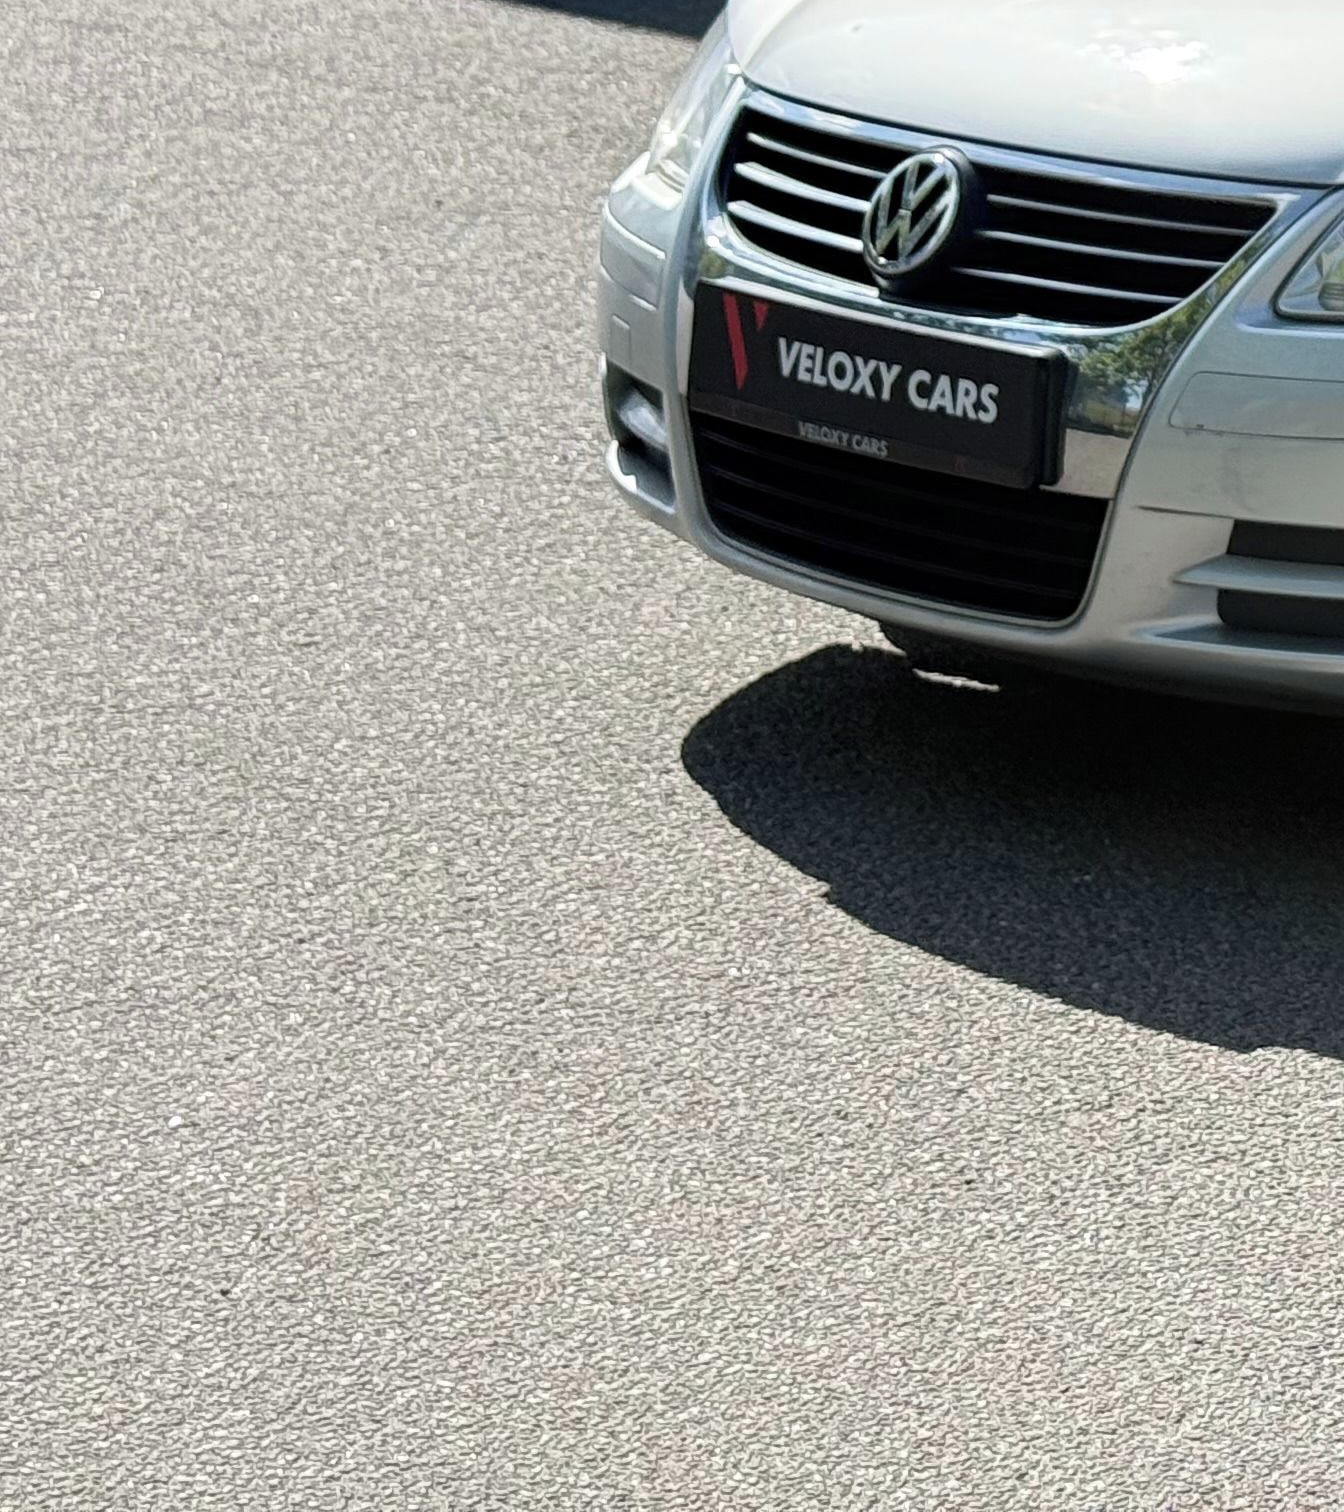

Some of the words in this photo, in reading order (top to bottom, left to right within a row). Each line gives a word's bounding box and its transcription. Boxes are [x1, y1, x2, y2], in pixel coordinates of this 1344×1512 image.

[865, 152, 960, 275] VW
[777, 337, 902, 402] VELOXY
[907, 369, 1000, 424] CARS
[798, 421, 850, 448] VELOXY
[852, 434, 888, 458] CARS
